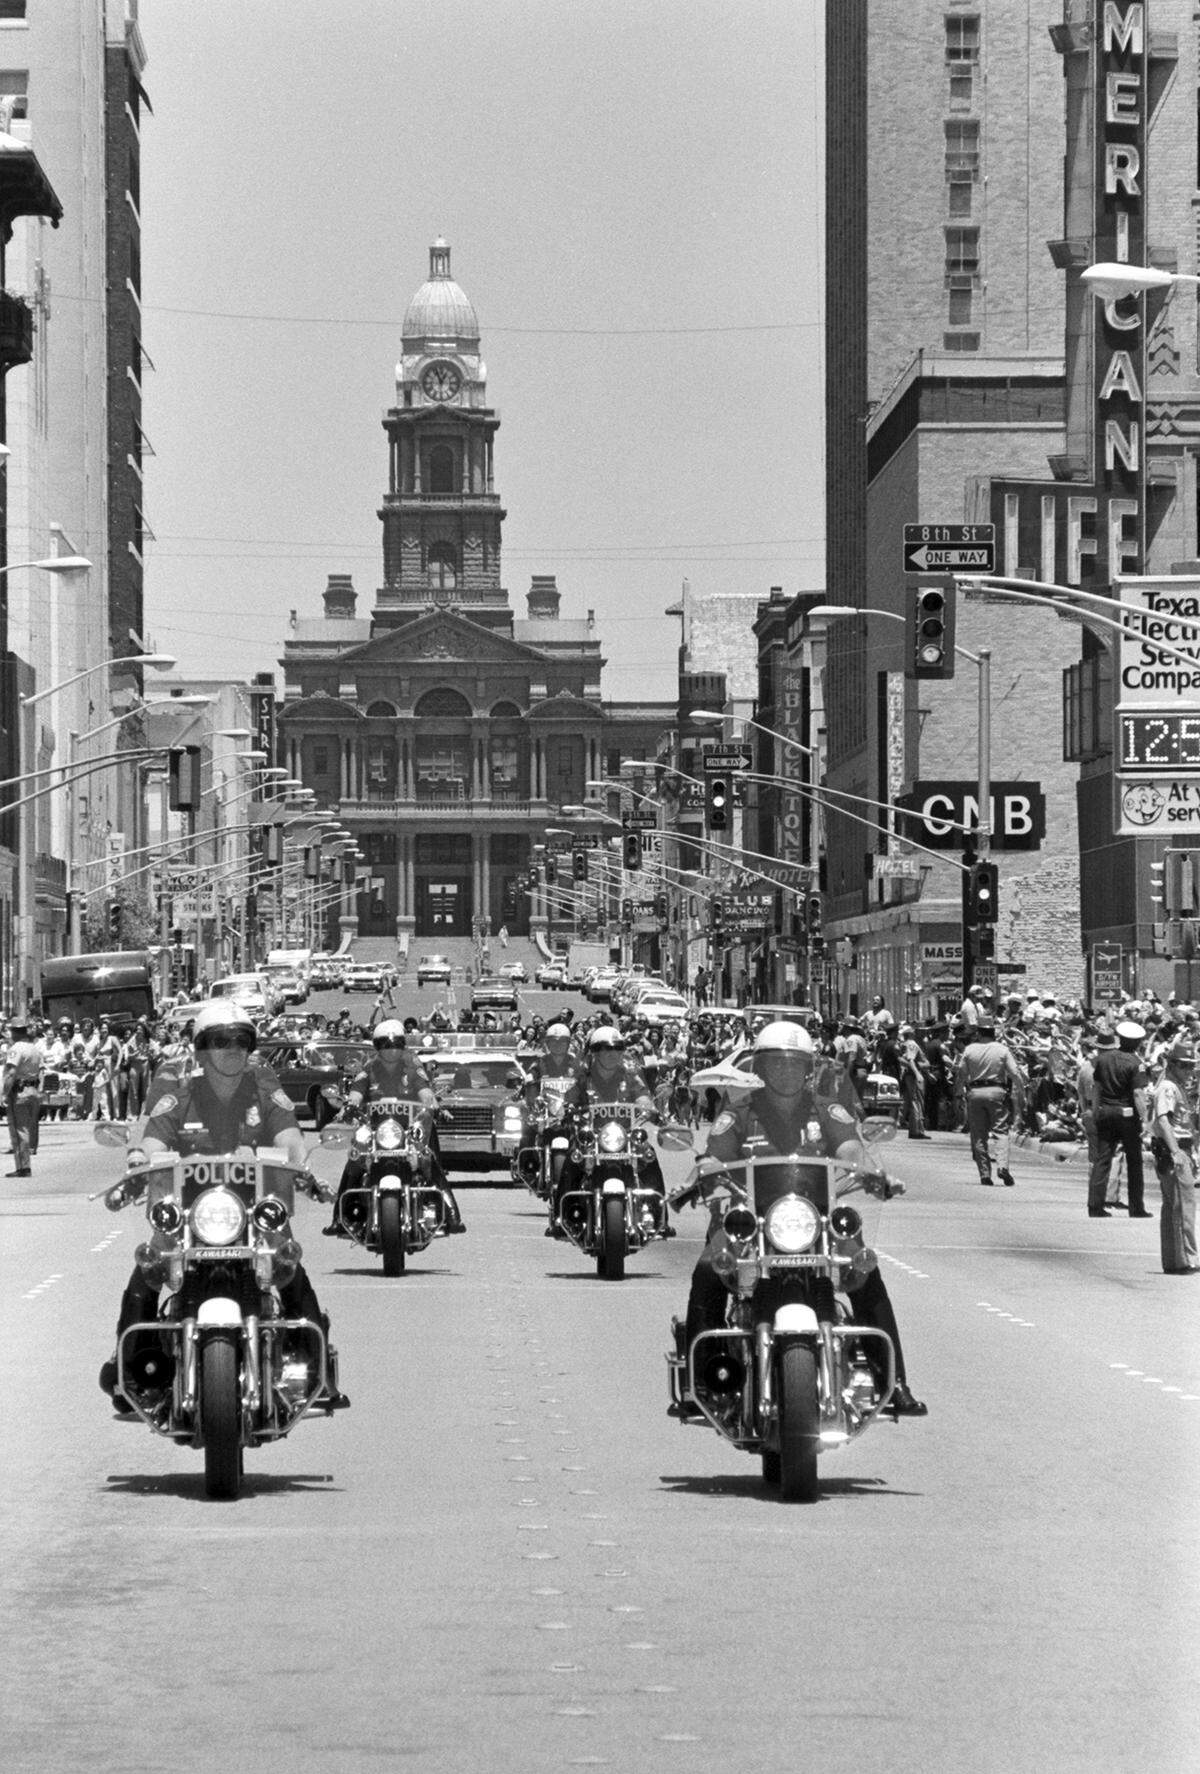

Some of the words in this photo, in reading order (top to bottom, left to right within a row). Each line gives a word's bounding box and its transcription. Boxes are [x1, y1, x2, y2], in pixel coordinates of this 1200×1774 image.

[922, 526, 950, 541] 8th
[961, 526, 977, 541] St
[925, 551, 952, 563] ONE
[958, 551, 985, 563] WAY
[1141, 591, 1200, 617] Texa
[783, 692, 801, 864] BLACKTONE
[1168, 782, 1189, 802] At
[922, 794, 1033, 835] CNB
[924, 946, 963, 958] MASS
[369, 1104, 410, 1116] POLICE
[592, 1107, 632, 1119] POLICE
[182, 1163, 257, 1186] POLICE
[195, 1249, 242, 1257] KAWASAKI
[771, 1257, 818, 1266] KAWASAKI
